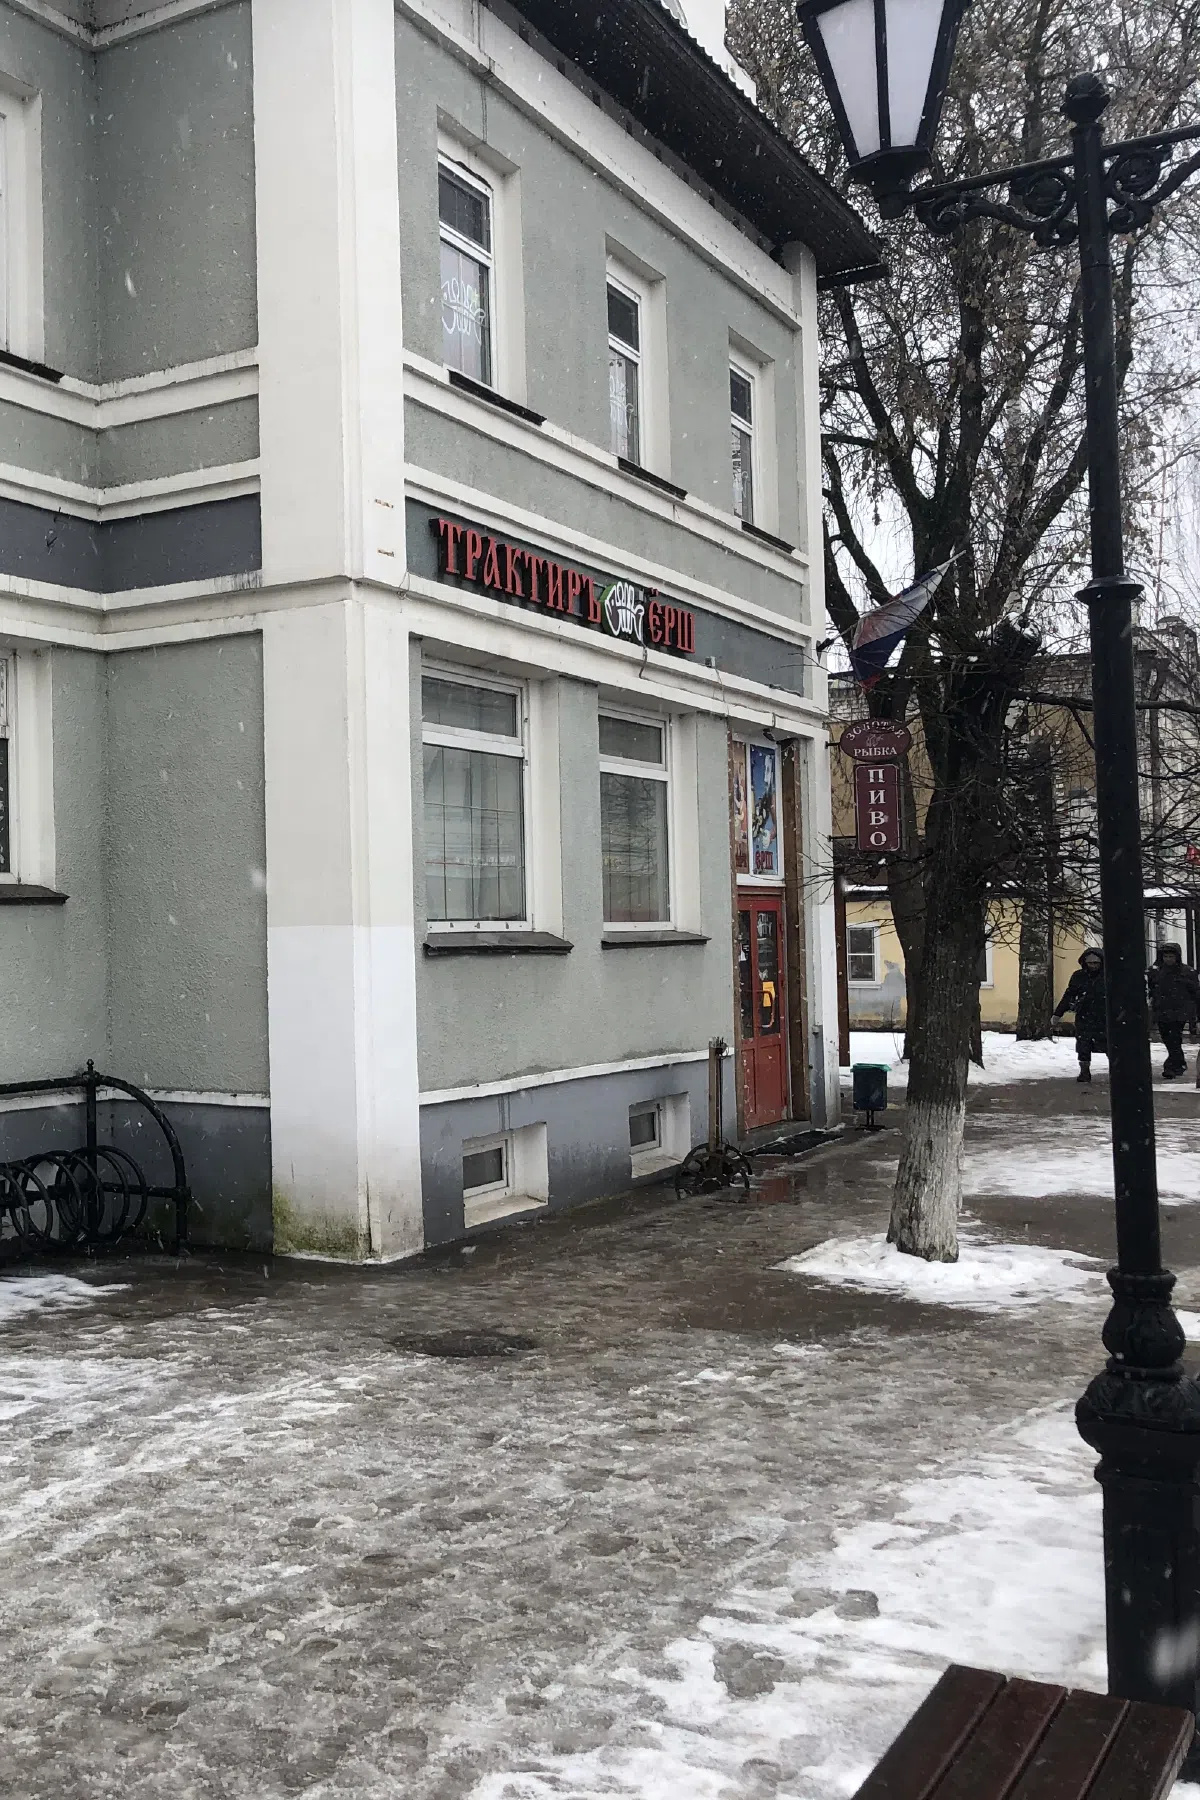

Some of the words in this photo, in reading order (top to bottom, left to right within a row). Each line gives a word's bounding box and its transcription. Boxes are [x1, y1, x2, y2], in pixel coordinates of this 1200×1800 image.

[436, 517, 602, 624] ТРАКТИРЪ
[845, 720, 906, 741] ЗОЛОТАЯ
[853, 747, 898, 757] РЫБКА
[867, 768, 888, 847] ПИВО
